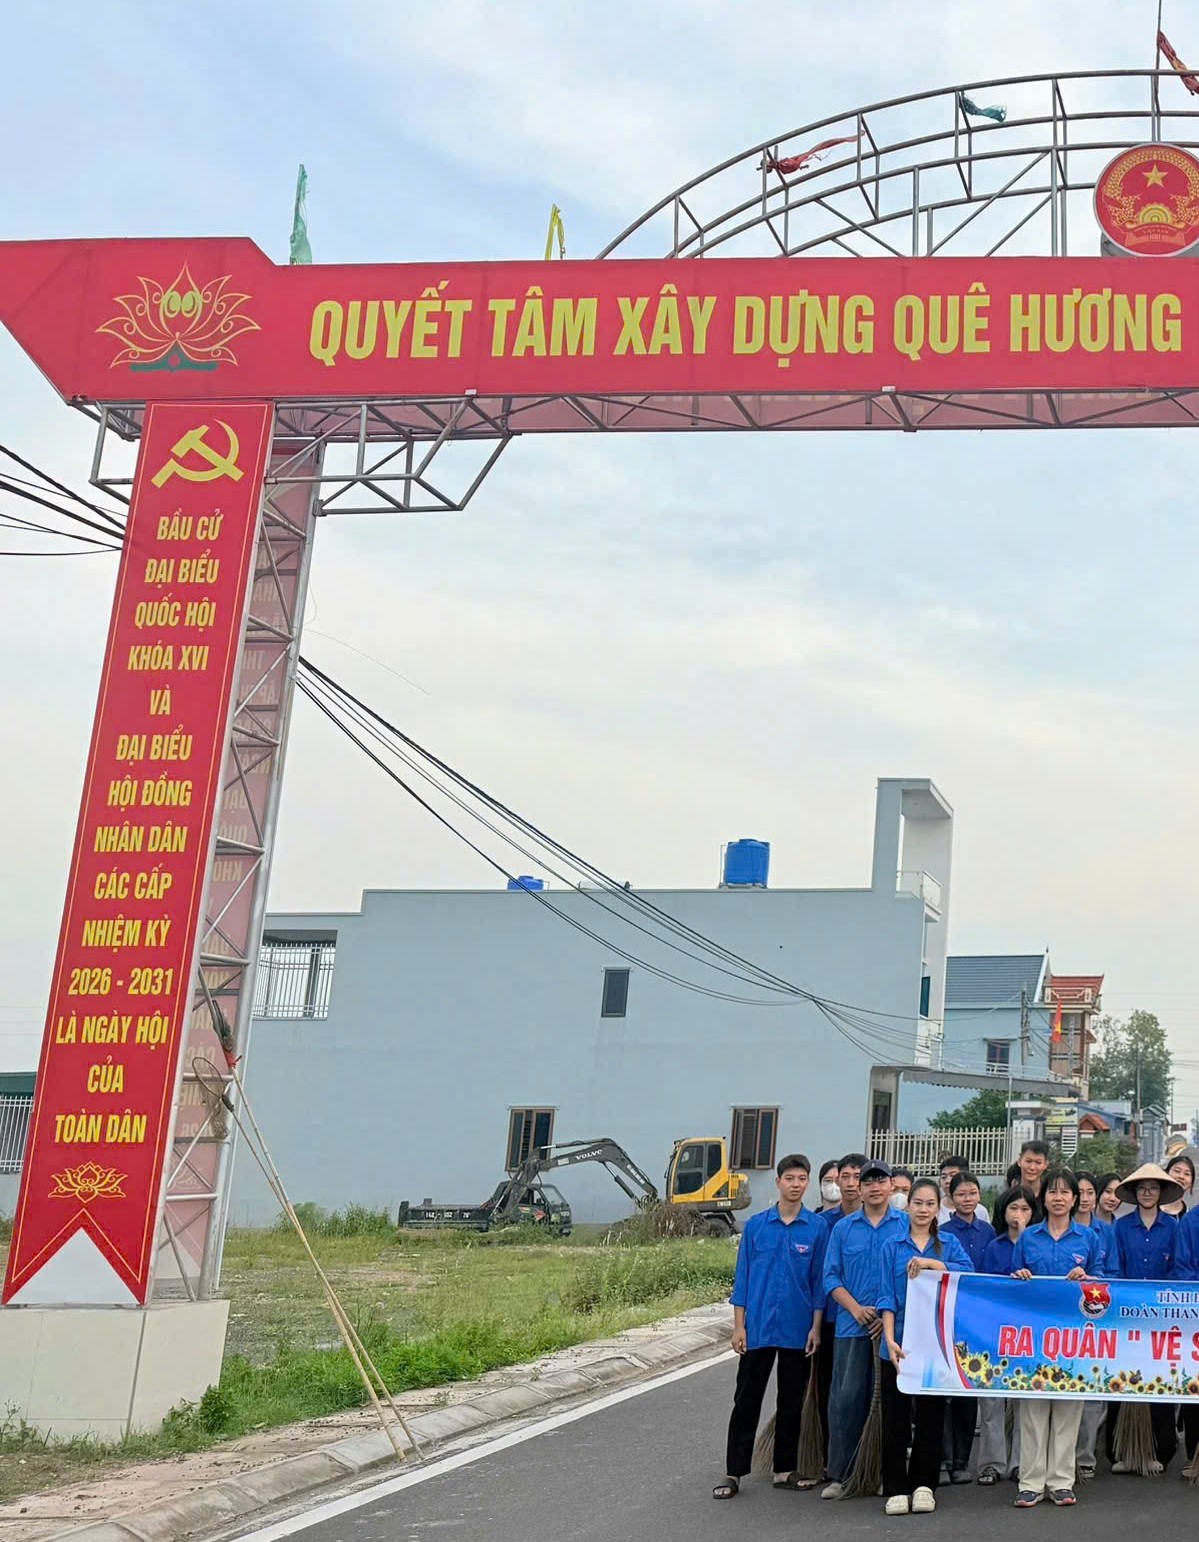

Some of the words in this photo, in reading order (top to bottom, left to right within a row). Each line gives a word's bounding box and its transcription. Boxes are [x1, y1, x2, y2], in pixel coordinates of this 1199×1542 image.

[309, 280, 472, 366] QUYẾT
[489, 286, 597, 357] TÂM
[615, 283, 716, 355] XÂY
[734, 289, 874, 368] DỰNG
[893, 282, 991, 361] QUÊ
[1010, 288, 1182, 353] HƯƠNG
[157, 507, 193, 541] BẦU
[196, 512, 224, 540] CỬ
[145, 559, 172, 590] ĐẠI
[179, 549, 219, 584] BIỂU
[135, 592, 181, 629] QUỐC
[185, 601, 216, 632] HỘI
[128, 640, 174, 671] KHÓA
[178, 646, 209, 671] XVI
[150, 684, 171, 715] VÀ
[116, 734, 145, 766] ĐẠI
[150, 724, 193, 761] BIỂU
[108, 775, 138, 810] HỘI
[142, 771, 192, 807] ĐỒNG
[94, 820, 143, 852] NHÂN
[148, 819, 188, 852] DÂN
[94, 866, 129, 899] CÁC
[134, 862, 172, 899] CẤP
[82, 914, 140, 953] NHIỆM
[145, 914, 171, 947] KỲ
[68, 968, 111, 995] 2026
[128, 968, 174, 995] 2031
[56, 1010, 78, 1044] LÀ
[81, 1010, 132, 1045] NGÀY
[135, 1010, 170, 1050] HỘI
[87, 1056, 124, 1093] CỦA
[54, 1110, 101, 1143] TOÀN
[105, 1109, 147, 1143] DÂN
[575, 1150, 603, 1160] VOLVO
[1121, 1303, 1160, 1318] ĐOÀN
[998, 1326, 1034, 1357] RA
[1042, 1321, 1118, 1361] QUÂN
[1151, 1324, 1182, 1368] VỆ
